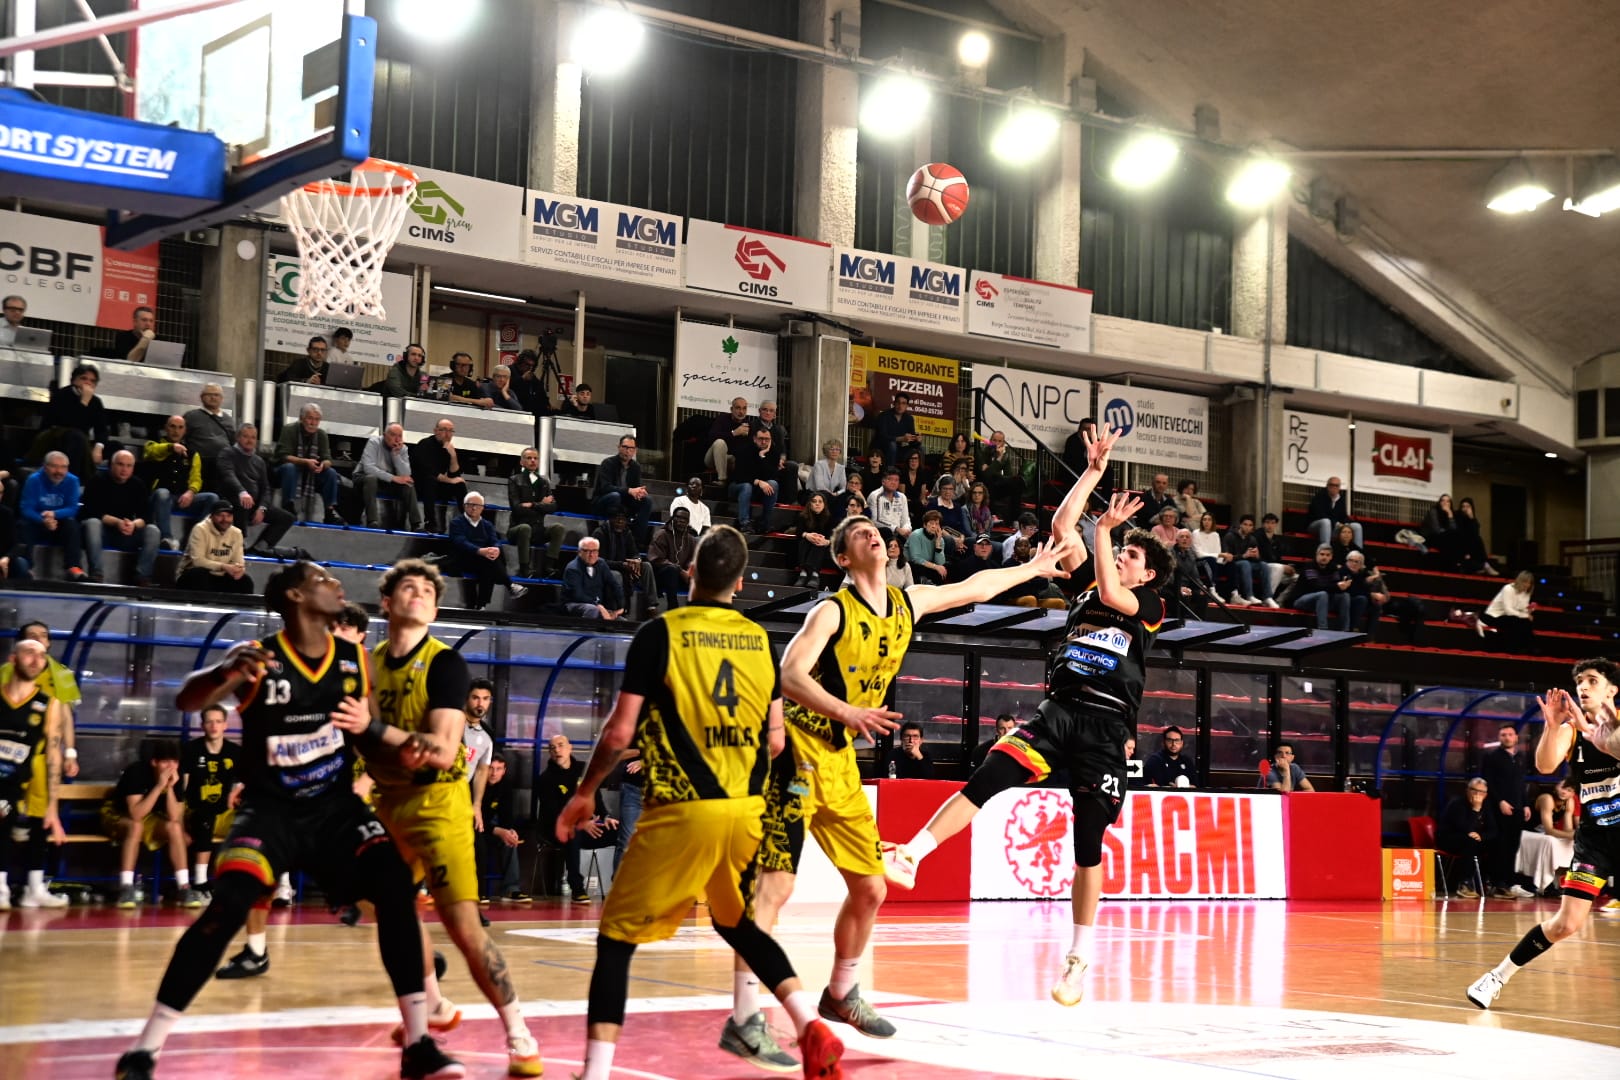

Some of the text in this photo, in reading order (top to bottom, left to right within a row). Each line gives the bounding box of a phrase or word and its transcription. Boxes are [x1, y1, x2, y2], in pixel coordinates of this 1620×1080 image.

[52, 134, 178, 171] SYSTEM
[446, 211, 473, 231] green
[534, 198, 599, 232] MGM
[409, 225, 455, 243] CIMS
[545, 229, 586, 241] STUDIO
[617, 211, 676, 246] MGM
[0, 242, 94, 280] CBF
[530, 245, 554, 255] SERVIZI
[554, 249, 586, 261] CONTABILI
[591, 255, 613, 265] FISCALI
[614, 258, 625, 266] PER
[625, 260, 650, 271] IMPRESE
[655, 265, 677, 275] PRIVATI
[840, 253, 895, 285] MGM
[738, 281, 778, 298] CIMS
[910, 265, 960, 296] MGM
[976, 300, 995, 309] CIMS
[308, 321, 327, 331] VISITE
[331, 317, 350, 327] FISICA
[878, 356, 955, 378] RISTORANTE
[683, 372, 773, 390] goccianello
[888, 378, 944, 397] PIZZERIA
[1021, 381, 1080, 424] NPC
[1136, 399, 1155, 410] studio
[1136, 412, 1203, 436] MONTEVECCHI
[1136, 432, 1157, 442] tecnica
[1163, 436, 1203, 448] comunicazione
[1380, 443, 1425, 470] CLAI
[878, 636, 889, 658] 5
[1071, 648, 1115, 668] euronics
[264, 679, 291, 706] 13
[712, 658, 739, 718] 4
[380, 689, 397, 713] 22
[275, 735, 329, 757] Allianz
[1577, 746, 1585, 763] 1
[1100, 774, 1120, 798] 21
[1582, 783, 1617, 799] Allianz
[358, 820, 385, 840] 13
[1101, 794, 1256, 894] SACMI
